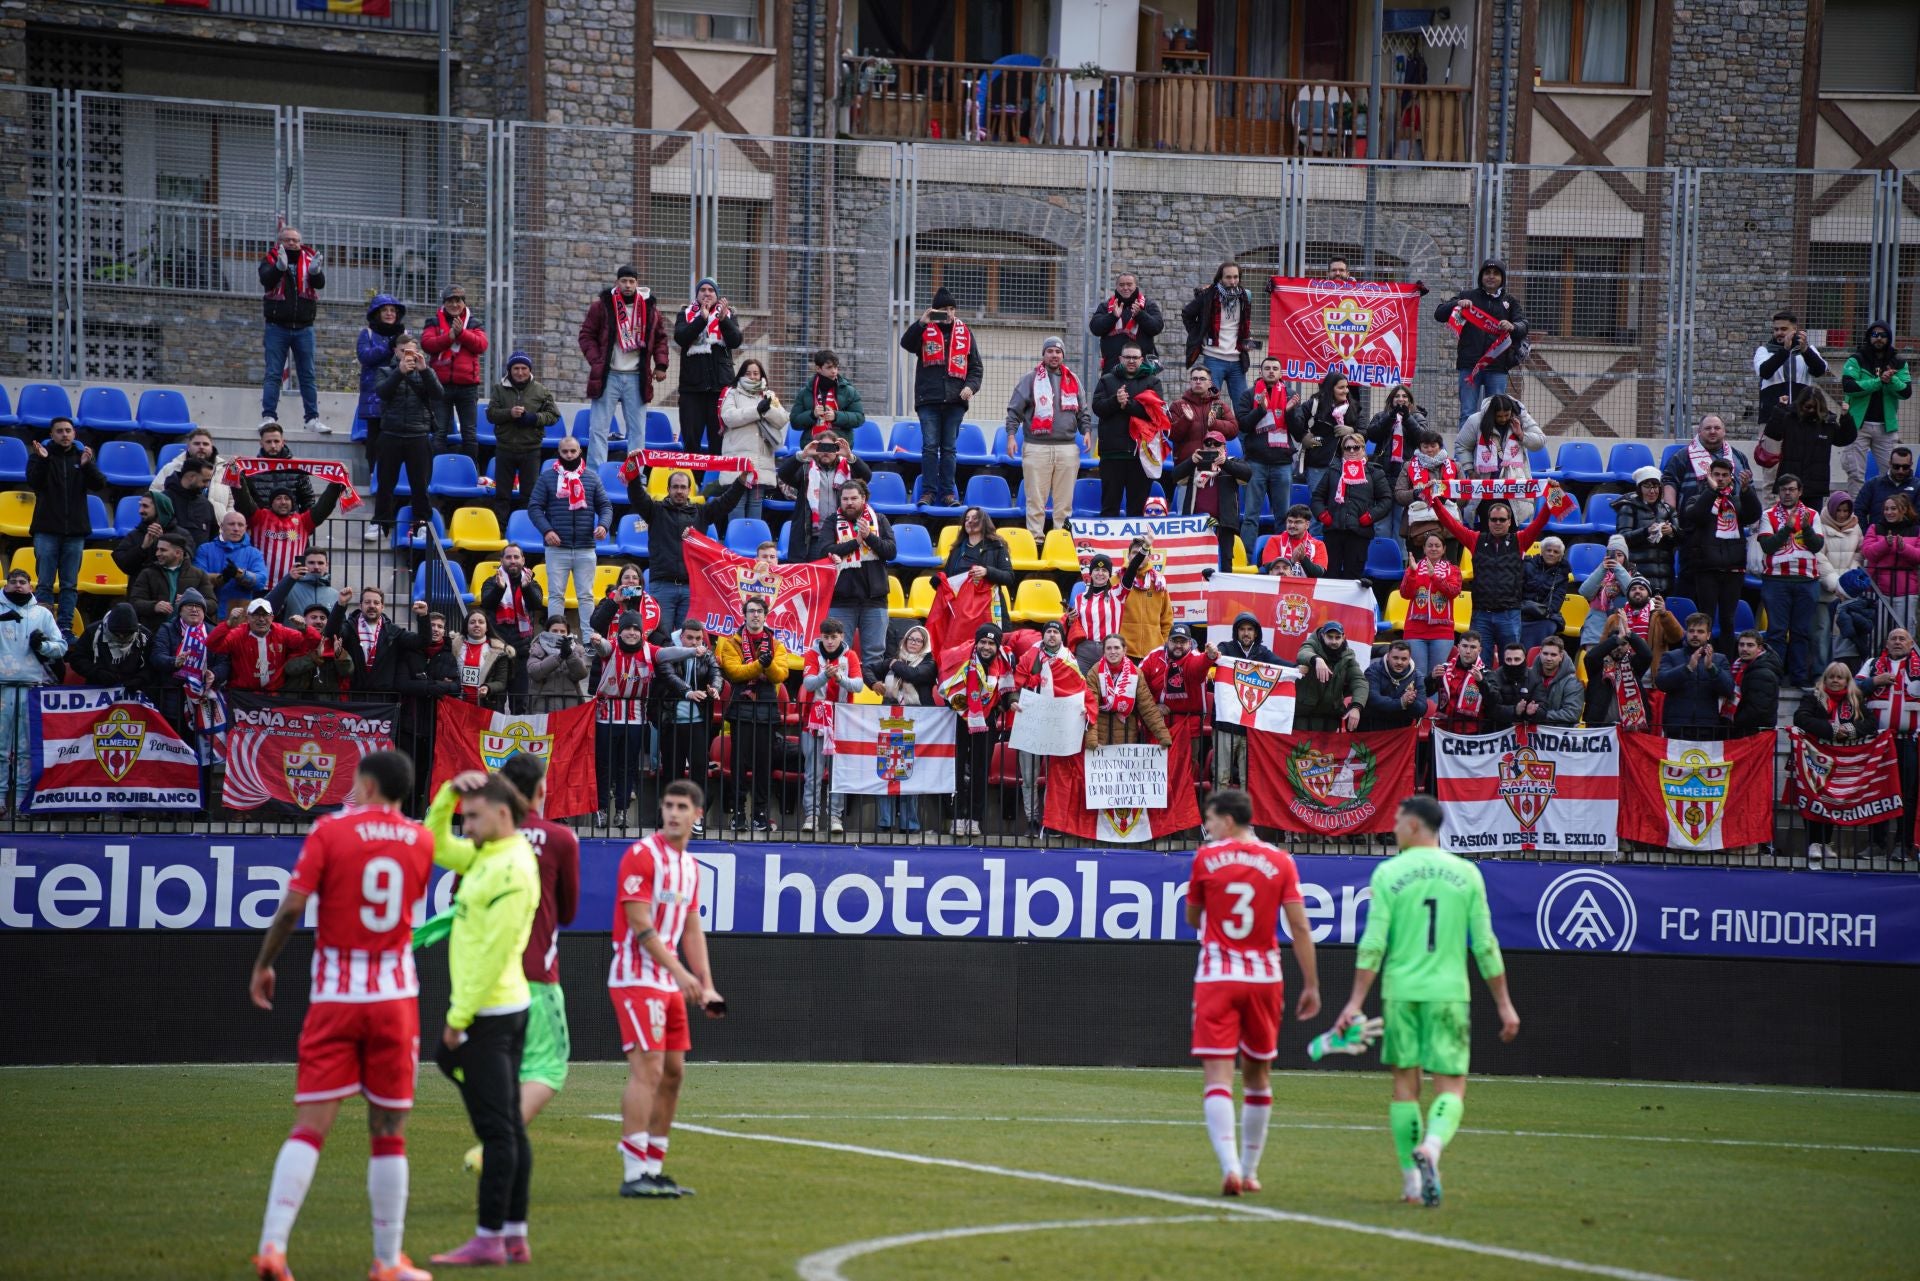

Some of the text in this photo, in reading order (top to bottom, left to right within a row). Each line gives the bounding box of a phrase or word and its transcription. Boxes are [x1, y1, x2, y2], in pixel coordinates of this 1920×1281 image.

[1287, 360, 1320, 380] U.D.
[1455, 482, 1542, 494] UD ALMERÍA
[1072, 520, 1115, 537] U.D.
[706, 612, 736, 635] U.D.
[774, 629, 805, 653] ERIA
[1236, 673, 1271, 689] ALMERIA
[43, 693, 92, 710] U.D.
[233, 707, 285, 728] PEÑA
[127, 725, 138, 734] D
[97, 738, 138, 748] ALMERIA
[1442, 731, 1612, 756] CAPITAL INDÁLICA
[1142, 759, 1158, 769] EL
[1667, 766, 1723, 779] U D
[287, 768, 330, 779] ALMERIA
[36, 791, 197, 804] ORGULLO ROJIBLANCO
[1669, 785, 1721, 797] ALMERIA
[1289, 800, 1314, 823] LOS
[1314, 802, 1376, 829] MOLINOS
[1831, 794, 1904, 821] PRIMERA
[1450, 831, 1498, 847] PASIÓN
[1543, 832, 1561, 845] EL
[1564, 832, 1607, 846] EXILIO
[359, 855, 404, 933] 9
[1222, 881, 1256, 940] 3
[1423, 896, 1437, 953] 1
[1660, 906, 1877, 948] FC ANDORRA
[645, 998, 667, 1026] 16
